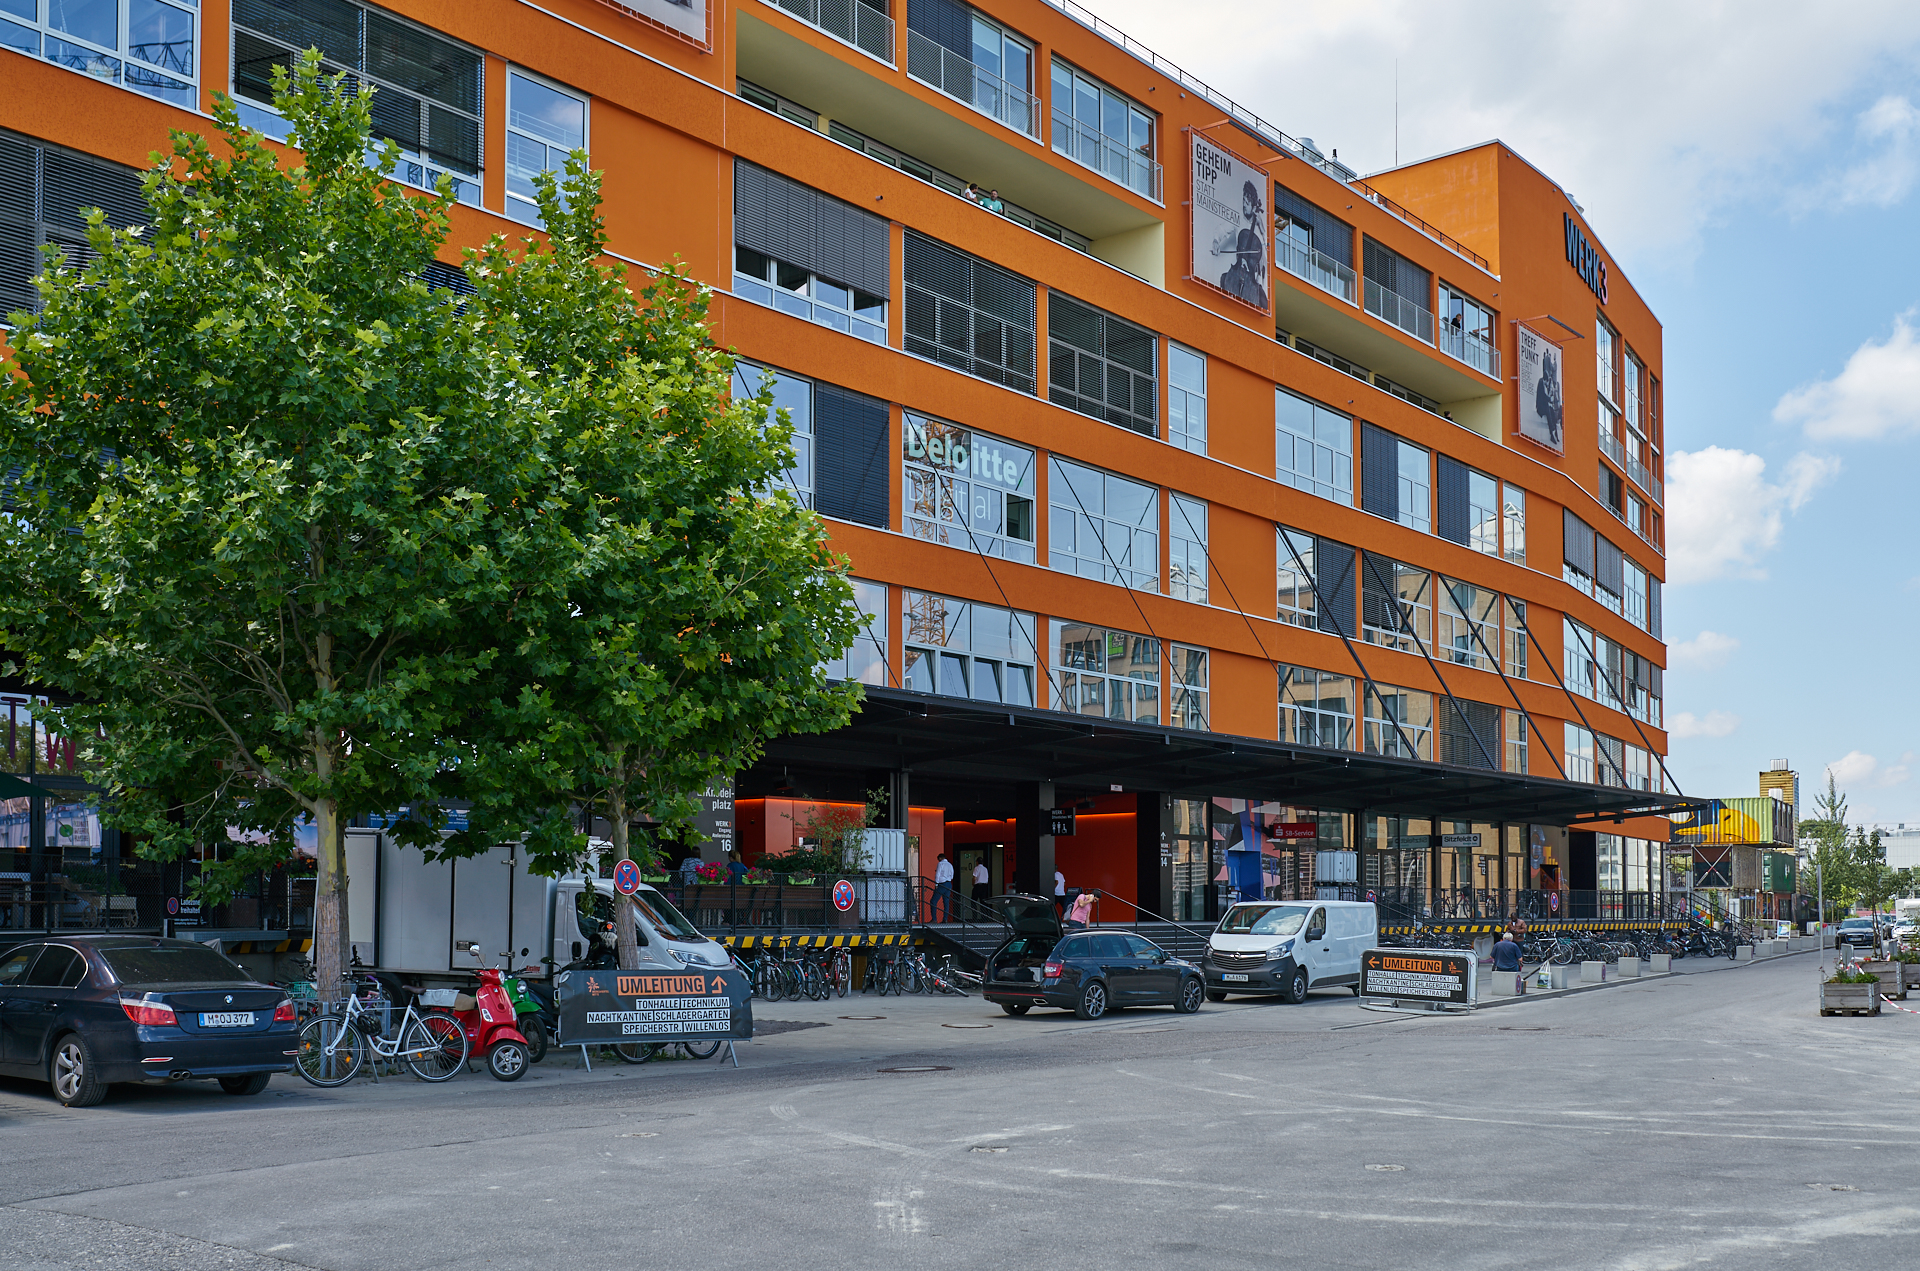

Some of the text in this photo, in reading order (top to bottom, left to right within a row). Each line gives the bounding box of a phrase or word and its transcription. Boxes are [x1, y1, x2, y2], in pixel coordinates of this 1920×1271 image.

[1196, 143, 1232, 177] GEHEIM
[1196, 160, 1217, 185] TIPP
[1196, 179, 1216, 198] STATT
[1196, 193, 1240, 225] MAINSTREAM
[1563, 212, 1608, 305] WERK3
[1521, 331, 1537, 351] TREFF
[1521, 345, 1539, 366] PUNKT
[908, 423, 1018, 486] Deloitte
[712, 799, 732, 811] platz
[721, 839, 732, 851] 16
[1444, 835, 1472, 843] Sitzfeldt
[1161, 857, 1168, 867] 14
[1384, 958, 1440, 972] UMLEITUNG
[1369, 970, 1396, 978] TONHALLE
[1397, 972, 1429, 981] TECHNIKUM
[620, 977, 703, 994] UMLEITUNG
[1368, 978, 1461, 991] NACHTKANTINE SCHLAGERGARTEN
[1368, 985, 1450, 997] WILLENLOS SPEICHERSTRASSE
[637, 998, 729, 1010] TONHALLE TECHNIKUM
[233, 1013, 250, 1024] 377
[588, 1010, 729, 1023] NACHTKANTINE SCHLAGERGARTEN
[624, 1021, 729, 1034] SPEICHERSTR. WILLENLOS
